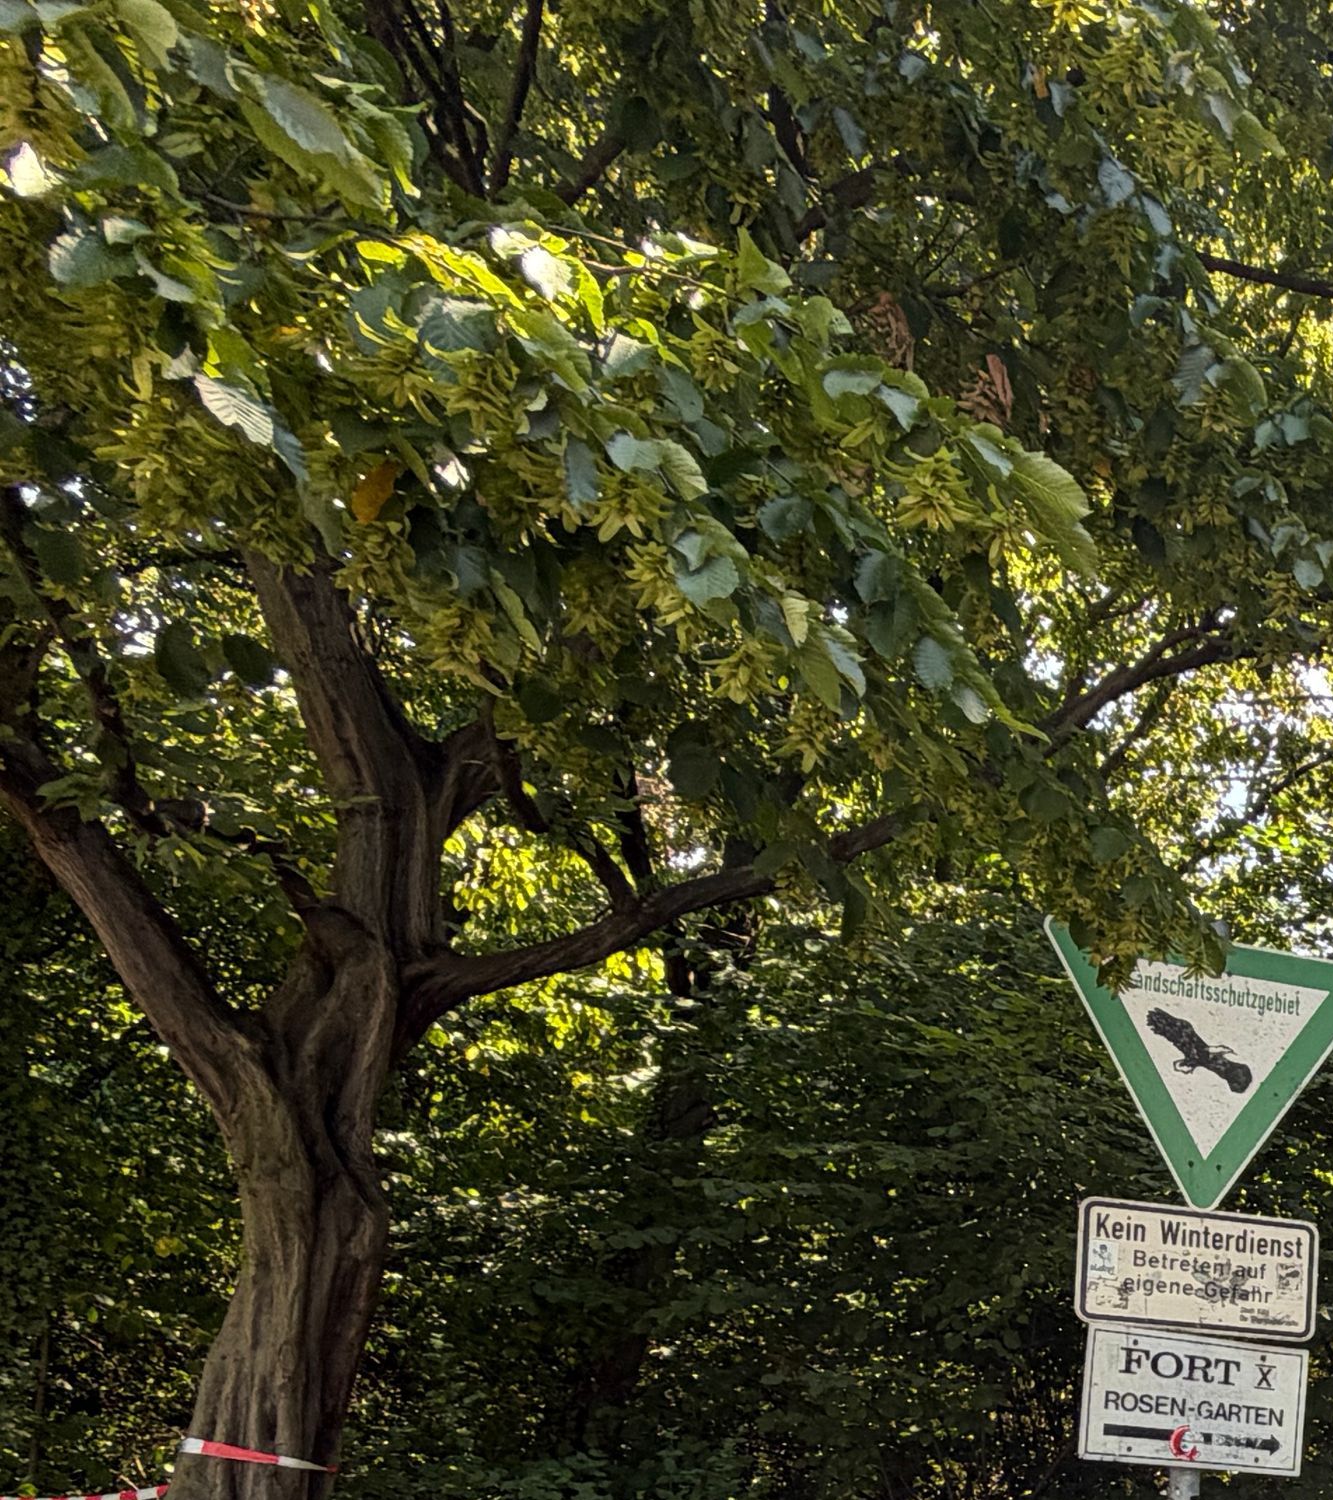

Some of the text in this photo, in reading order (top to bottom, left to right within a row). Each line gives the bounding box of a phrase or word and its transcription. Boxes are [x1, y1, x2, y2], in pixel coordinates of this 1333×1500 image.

[1133, 971, 1301, 1016] andschaftsschutzgebiet
[1096, 1212, 1303, 1259] Kein Winterdienst
[1133, 1249, 1226, 1276] Betreten
[1234, 1263, 1267, 1280] auf
[1123, 1274, 1274, 1304] eigene Gefahr
[1118, 1346, 1277, 1390] FORT X
[1103, 1390, 1284, 1427] ROSEN-GARTEN
